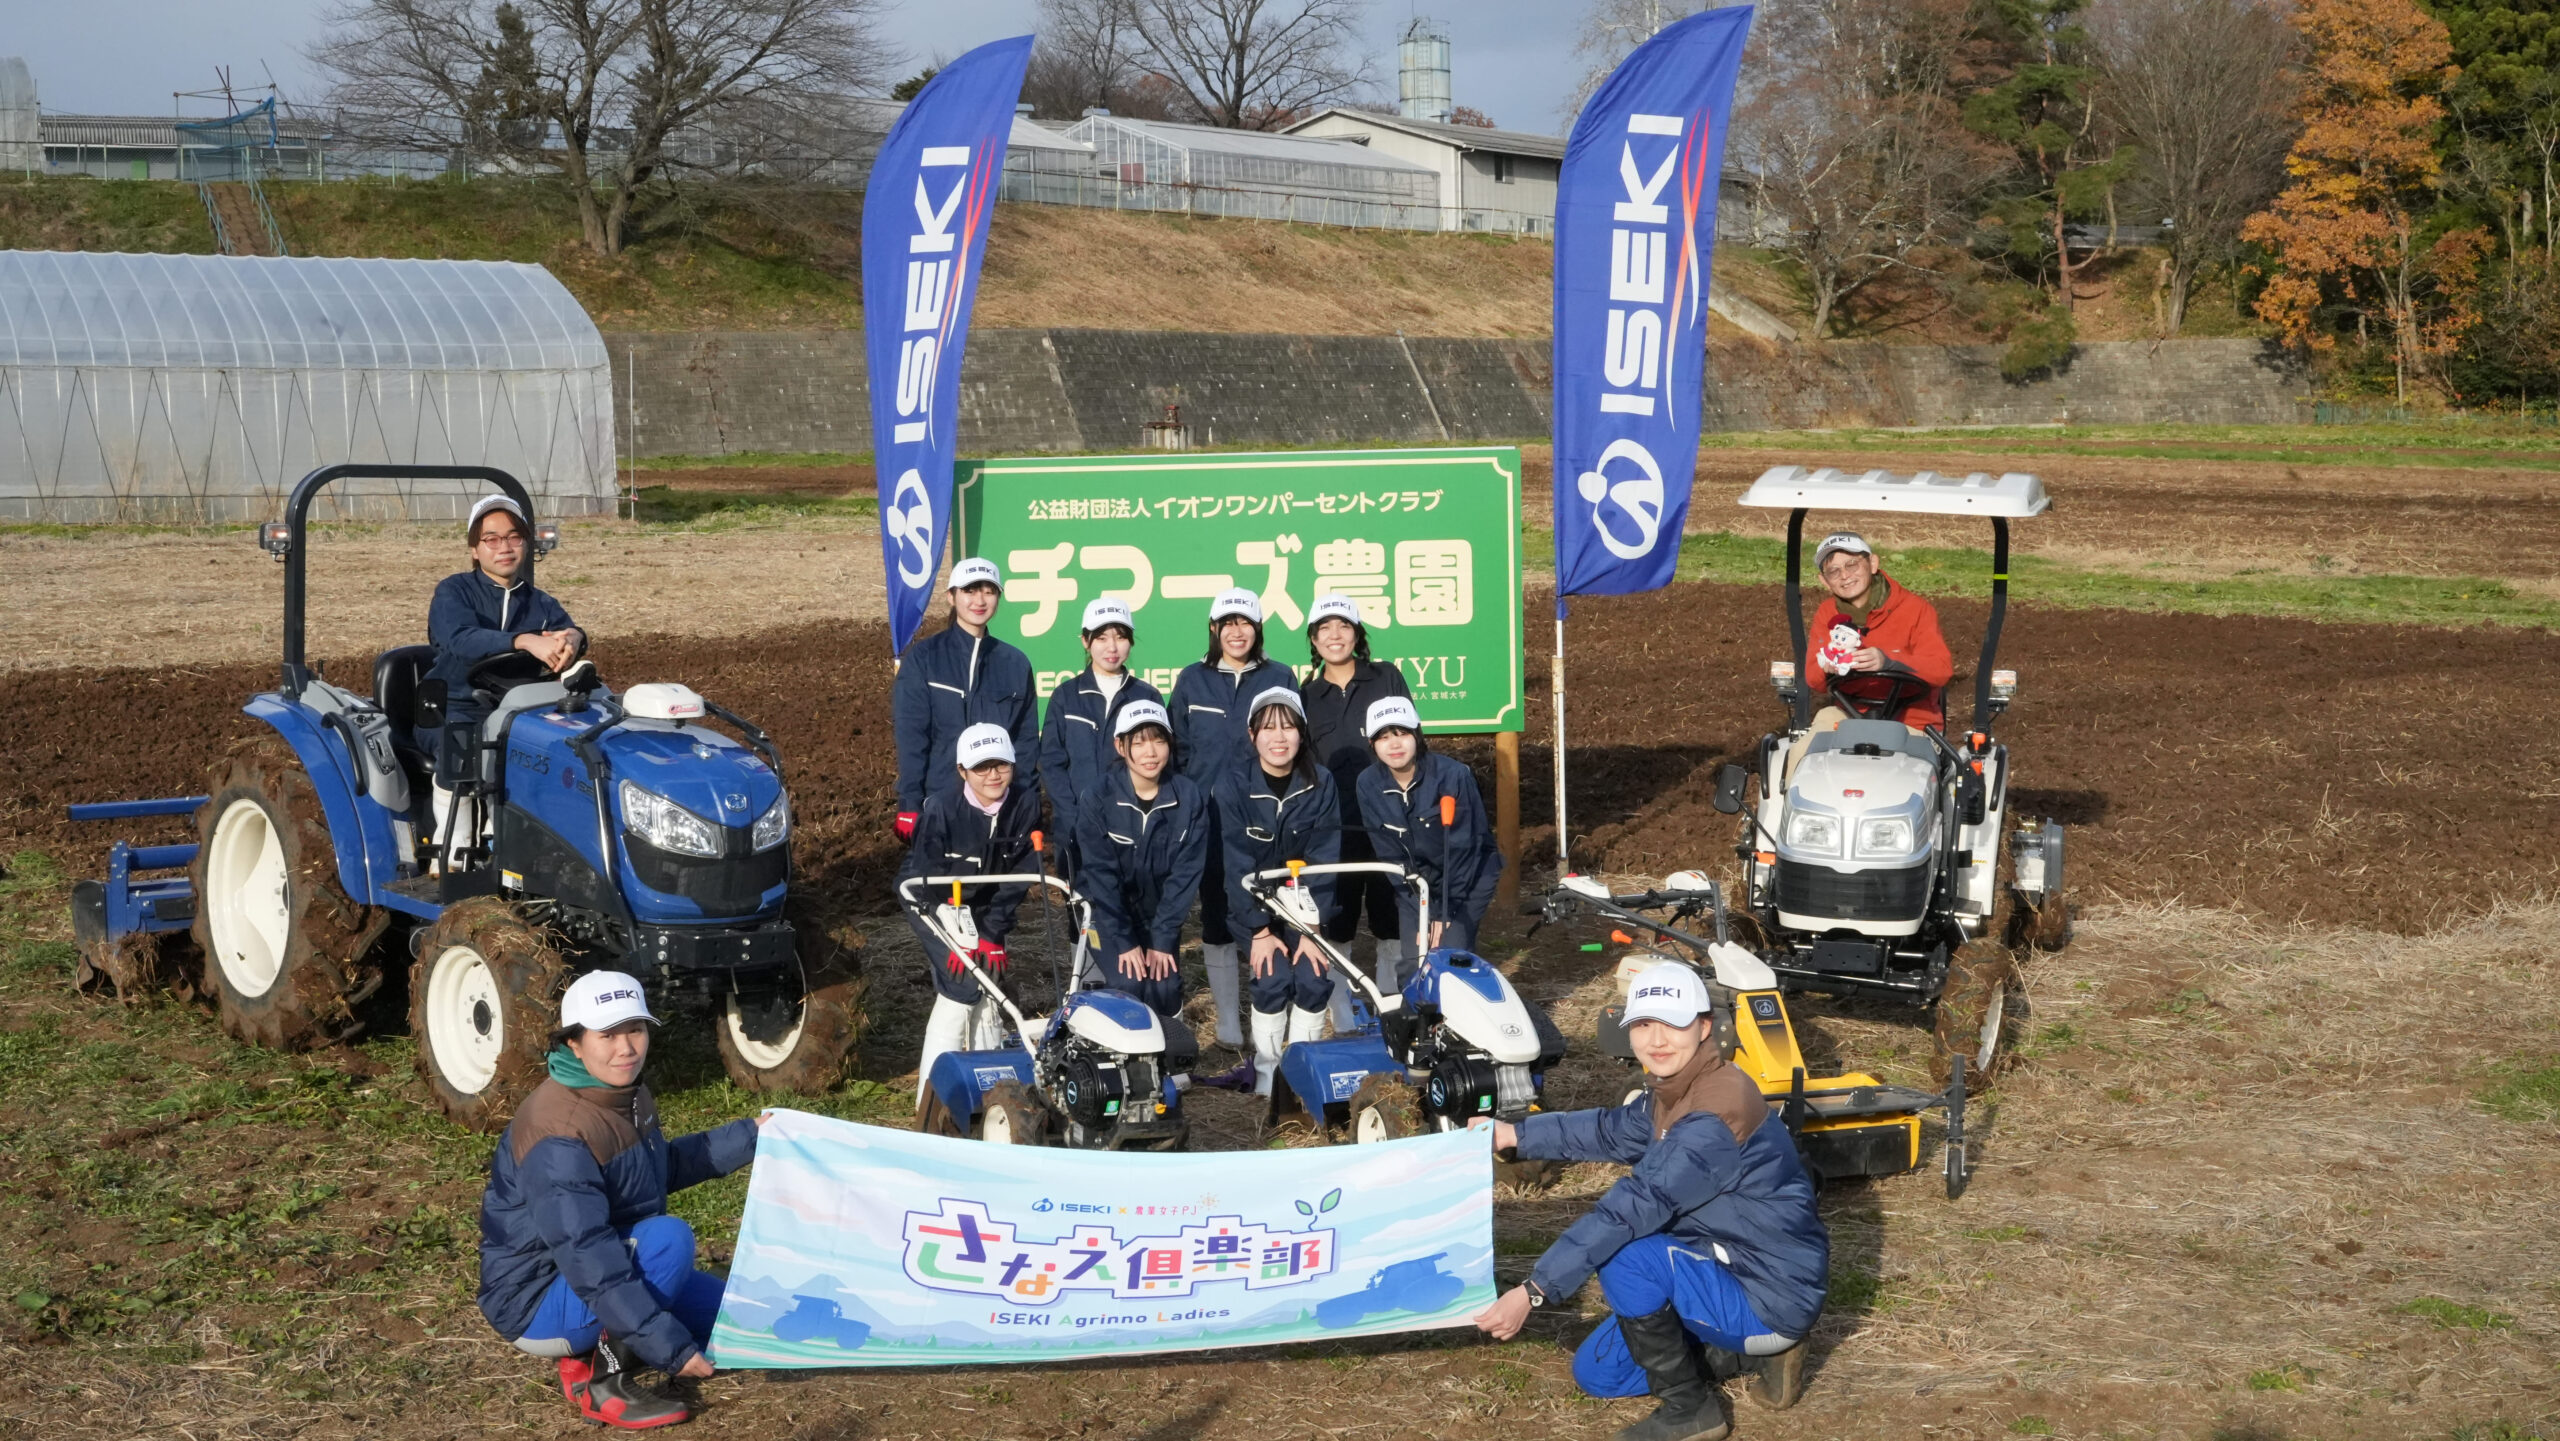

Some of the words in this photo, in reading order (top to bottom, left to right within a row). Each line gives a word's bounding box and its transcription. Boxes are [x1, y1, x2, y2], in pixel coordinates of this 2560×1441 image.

[1600, 113, 1684, 416] ISEKI
[894, 146, 971, 444] ISEKI
[1028, 489, 1444, 520] 公益財団法人イオンワンパーセントクラブ
[966, 566, 996, 577] ISEKI
[1222, 598, 1254, 608] ISEKI
[1320, 601, 1351, 611] ISEKI
[1095, 606, 1126, 616] ISEKI
[1130, 708, 1162, 719] ISEKI
[1374, 707, 1406, 720] ISEKI
[970, 737, 1003, 750] ISEKI
[594, 989, 640, 1006] ISEKI
[1635, 986, 1680, 1000] ISEKI
[1060, 1203, 1111, 1214] ISEKI
[917, 1213, 1321, 1297] さなえ倶楽部
[990, 1312, 1050, 1326] ISEKI
[1058, 1313, 1147, 1328] Agrinno
[1157, 1308, 1231, 1322] Ladies
